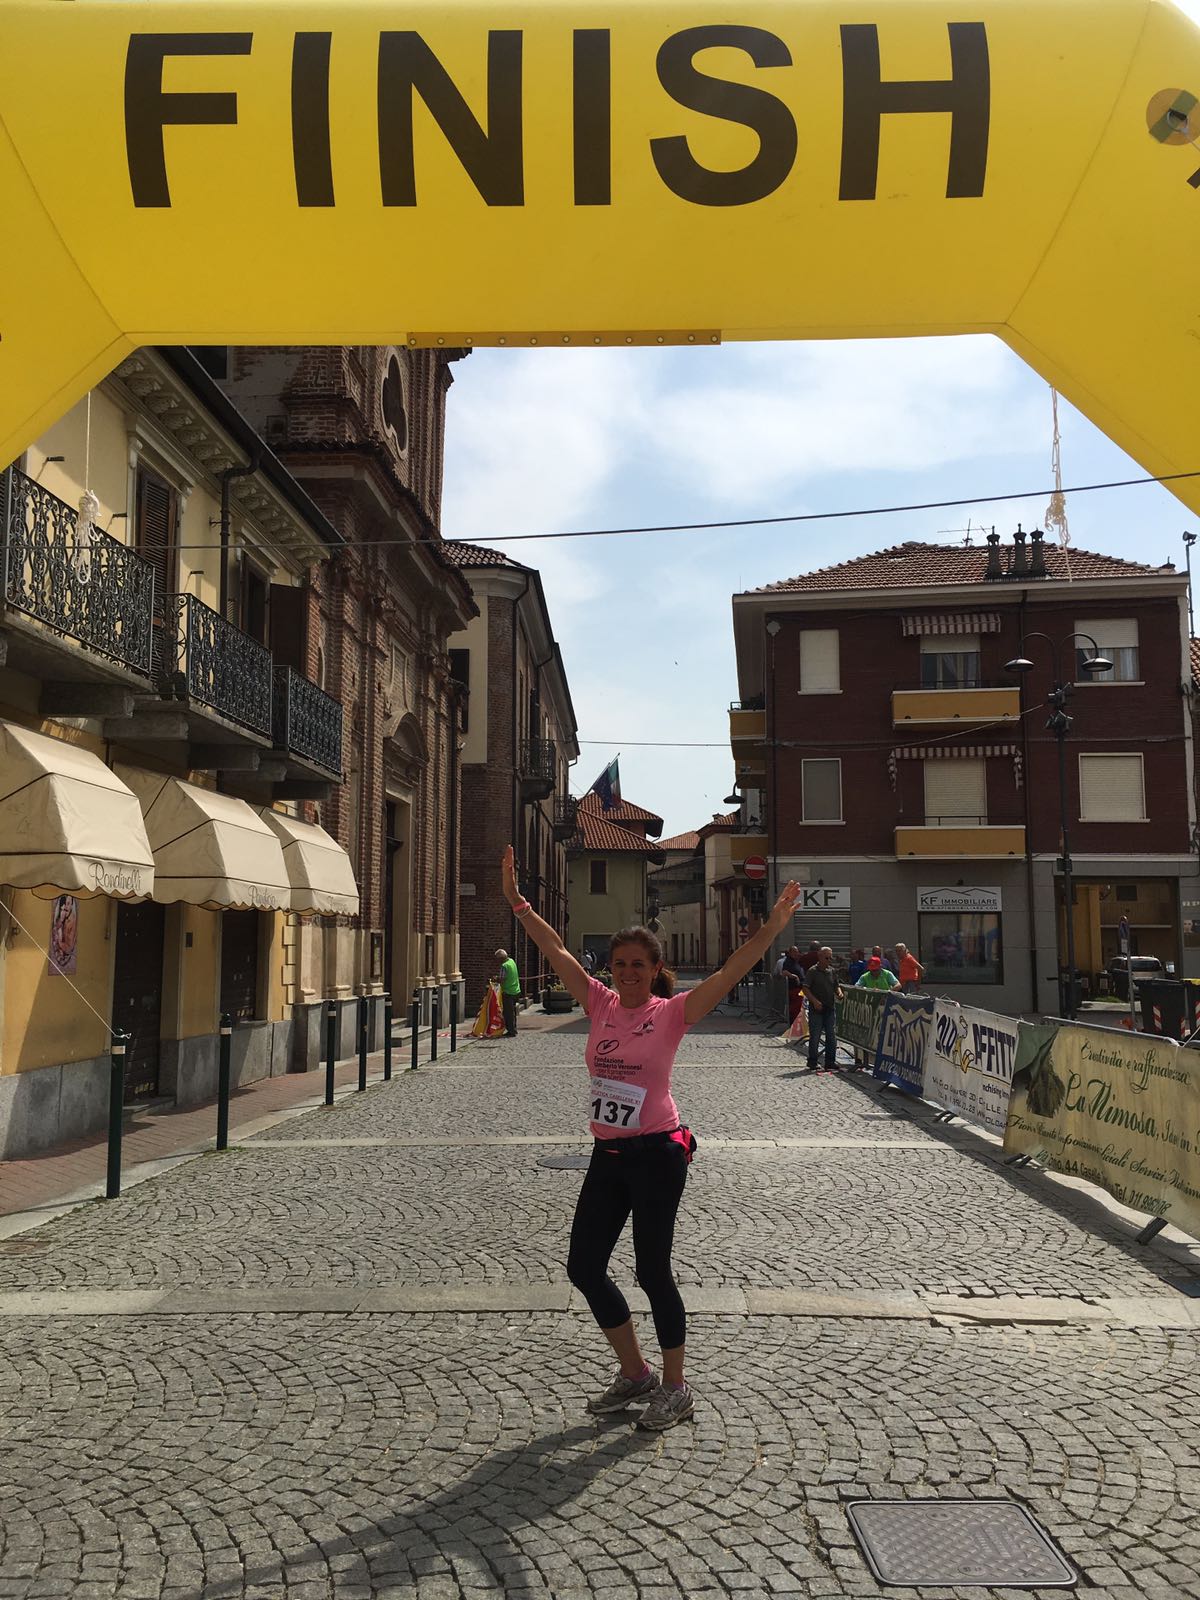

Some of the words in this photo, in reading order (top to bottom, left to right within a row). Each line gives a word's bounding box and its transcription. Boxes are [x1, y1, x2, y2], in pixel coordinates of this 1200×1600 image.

[124, 22, 992, 209] FINISH
[803, 889, 840, 906] KF
[920, 896, 938, 905] KF
[1065, 1069, 1085, 1112] La
[592, 1098, 635, 1126] 137
[1065, 1159, 1078, 1174] 44
